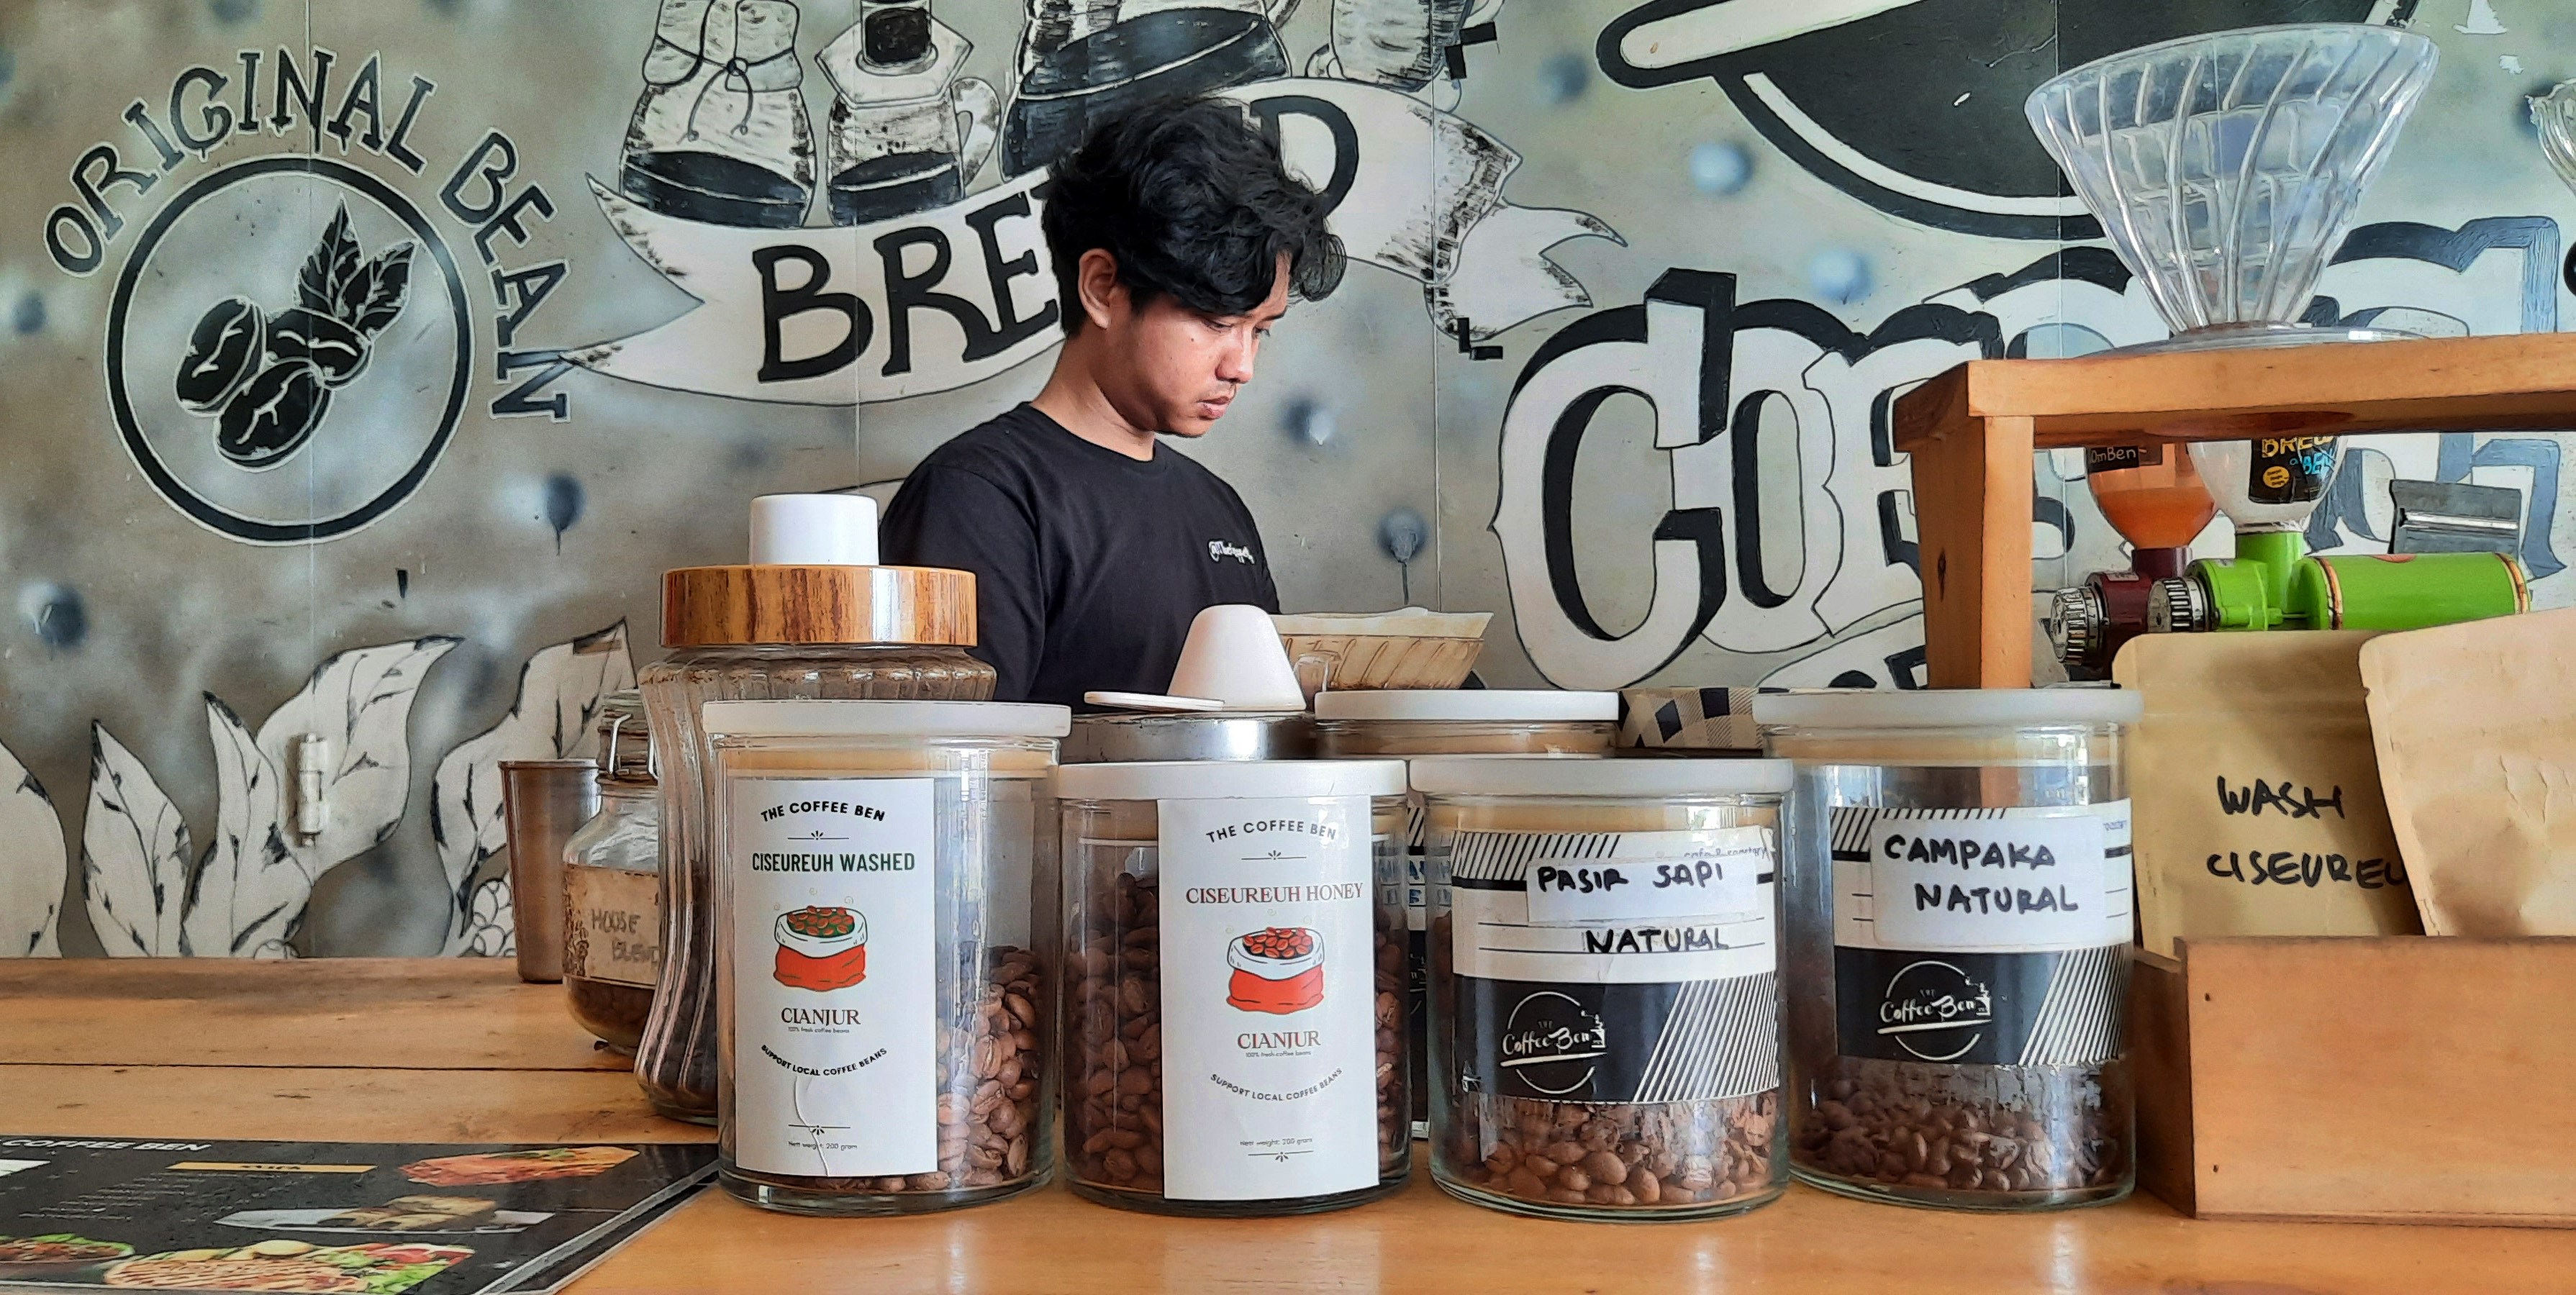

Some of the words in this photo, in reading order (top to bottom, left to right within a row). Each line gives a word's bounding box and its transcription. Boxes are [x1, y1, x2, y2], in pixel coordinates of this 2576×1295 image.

[45, 45, 436, 277] ORIGINAL
[436, 127, 571, 424] BEAN
[2216, 775, 2344, 819] WASH
[761, 805, 784, 822] THE
[789, 801, 848, 814] COFFEE
[854, 805, 885, 822] BEN
[1206, 825, 1237, 843] THE
[1243, 820, 1305, 833] COFFEE
[1310, 824, 1337, 840] BEN
[752, 853, 833, 872] CISEUREUH
[840, 853, 915, 871] WASHED
[1884, 834, 2056, 870] CAMPAKA
[1537, 866, 1628, 894] PASIR
[1653, 859, 1723, 889] SAPI
[1186, 886, 1300, 904] CISEUREUH
[1306, 883, 1363, 901] HONEY
[1915, 883, 2079, 915] NATURAL
[591, 909, 641, 933] HOUSE
[1586, 928, 1729, 953] NATURAL
[781, 1008, 861, 1026] CIANJUR
[1880, 999, 1932, 1022] Coffee
[1931, 995, 1975, 1022] Ben
[1238, 1030, 1321, 1050] CIANJUR
[1502, 1031, 1552, 1055] Coffee
[1548, 1027, 1591, 1054] Ben
[761, 1045, 792, 1069] SUPPORT
[793, 1065, 820, 1076] LOCAL
[823, 1063, 858, 1076] COFFEE
[858, 1048, 887, 1068] BEANS
[1210, 1073, 1250, 1097] SUPPORT
[1252, 1091, 1284, 1101] LOCAL
[1286, 1086, 1318, 1100] COFFEE
[1319, 1068, 1343, 1089] BEANS
[2, 1138, 136, 1150] COFFEE
[132, 1142, 212, 1152] BEN
